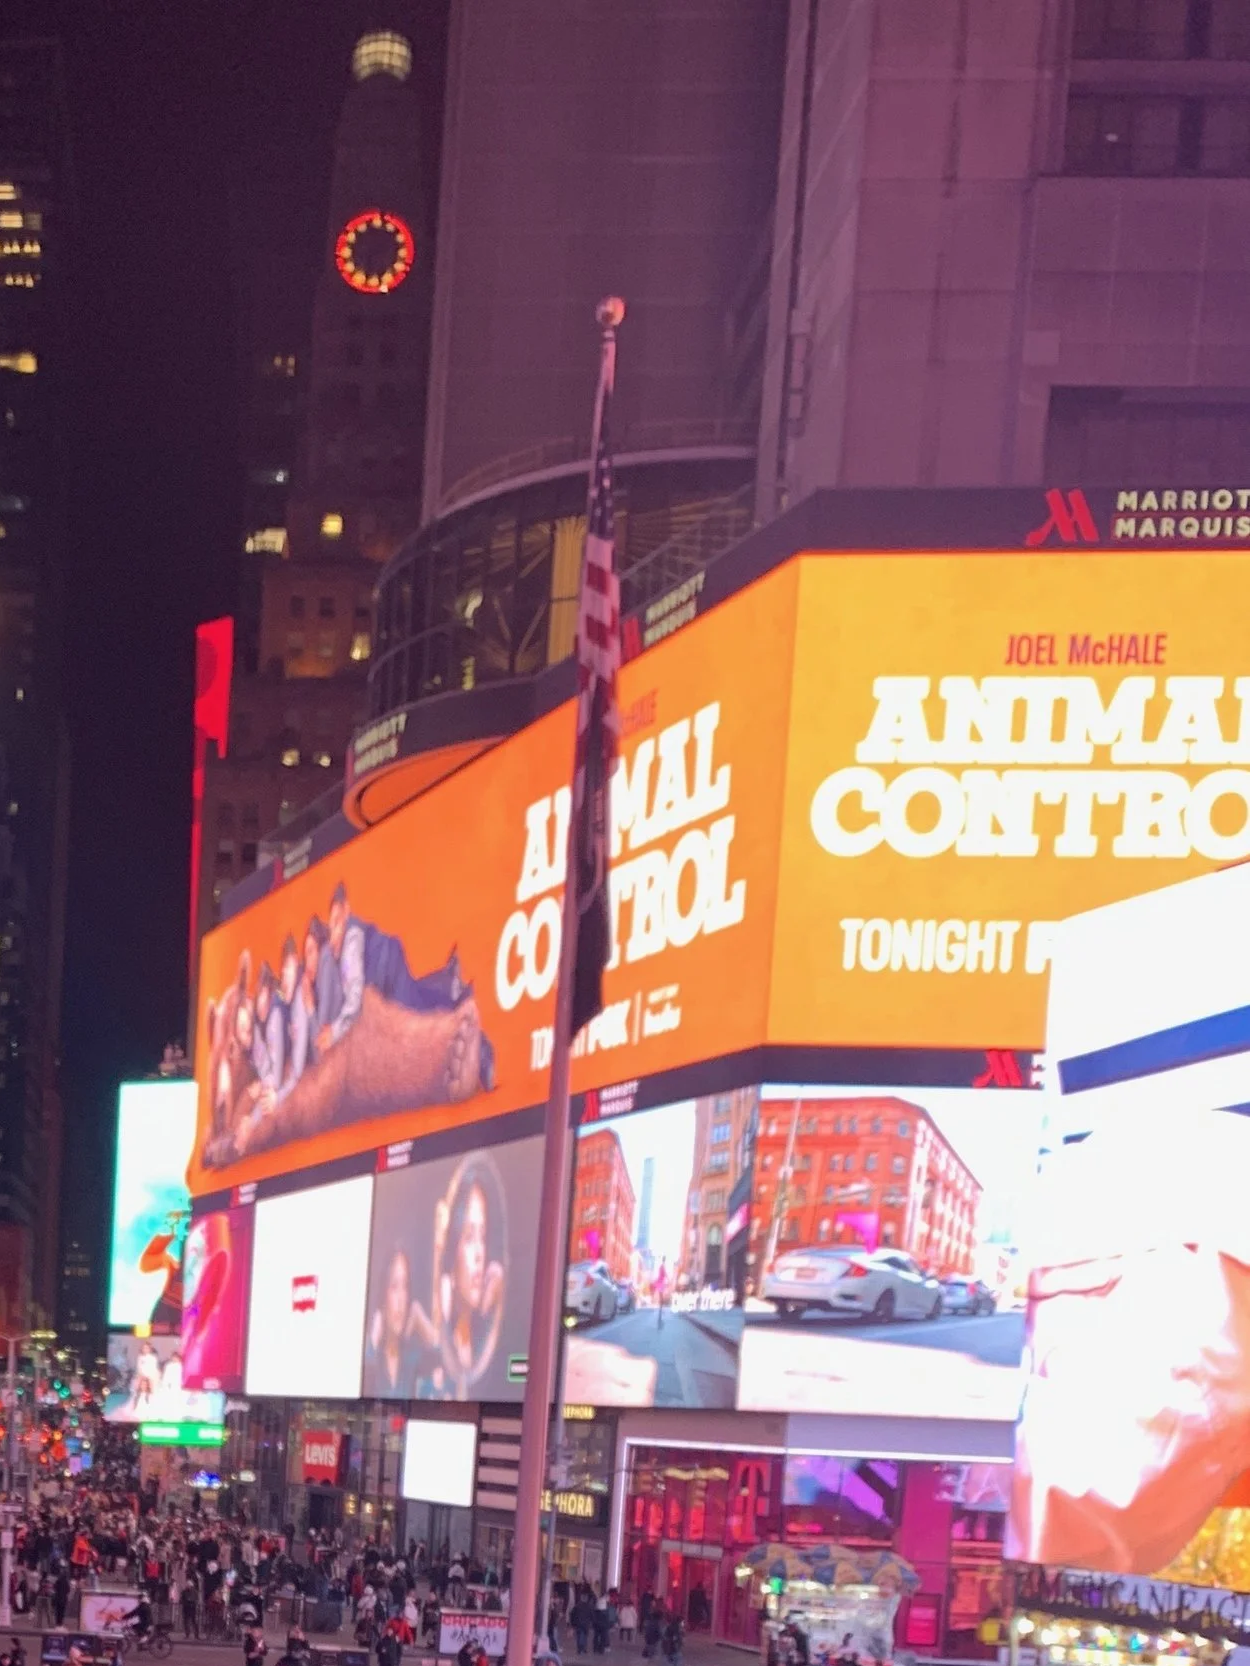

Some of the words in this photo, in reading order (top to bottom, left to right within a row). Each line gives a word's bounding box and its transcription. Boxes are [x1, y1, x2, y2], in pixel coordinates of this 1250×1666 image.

[1114, 516, 1250, 539] MARQUIS
[1116, 488, 1250, 512] MARRIOT
[1005, 634, 1058, 666] JOEL
[1068, 633, 1167, 665] McHALE
[855, 676, 1250, 765] ANIMA
[516, 701, 731, 905] AMAL
[810, 767, 1250, 860] CONTRO
[494, 815, 747, 1012] COTROL
[840, 918, 1020, 973] TONIGHT
[1178, 1586, 1250, 1633] EAGL
